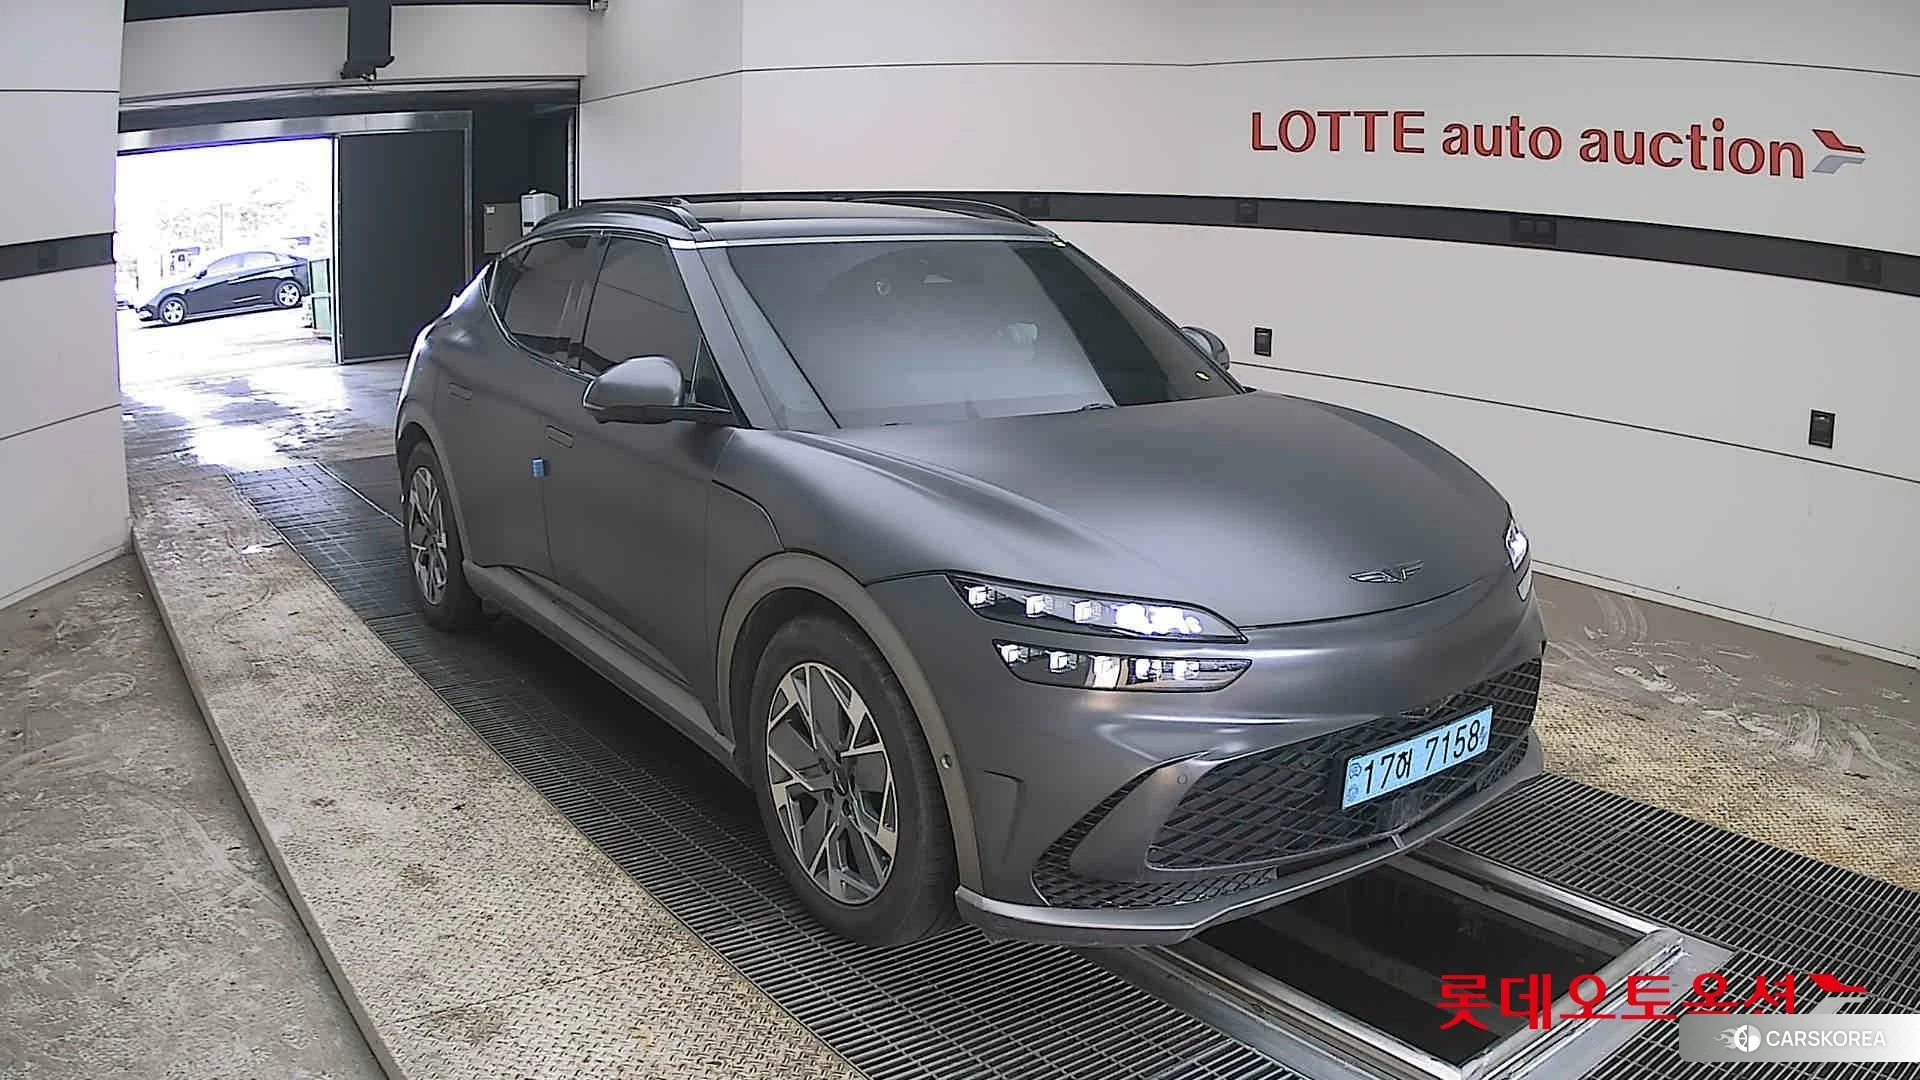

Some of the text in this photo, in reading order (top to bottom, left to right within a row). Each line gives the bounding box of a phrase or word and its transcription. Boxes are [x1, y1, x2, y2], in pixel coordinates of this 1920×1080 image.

[1250, 110, 1805, 178] LOTTE auto auction
[1364, 719, 1480, 794] 17허 7158
